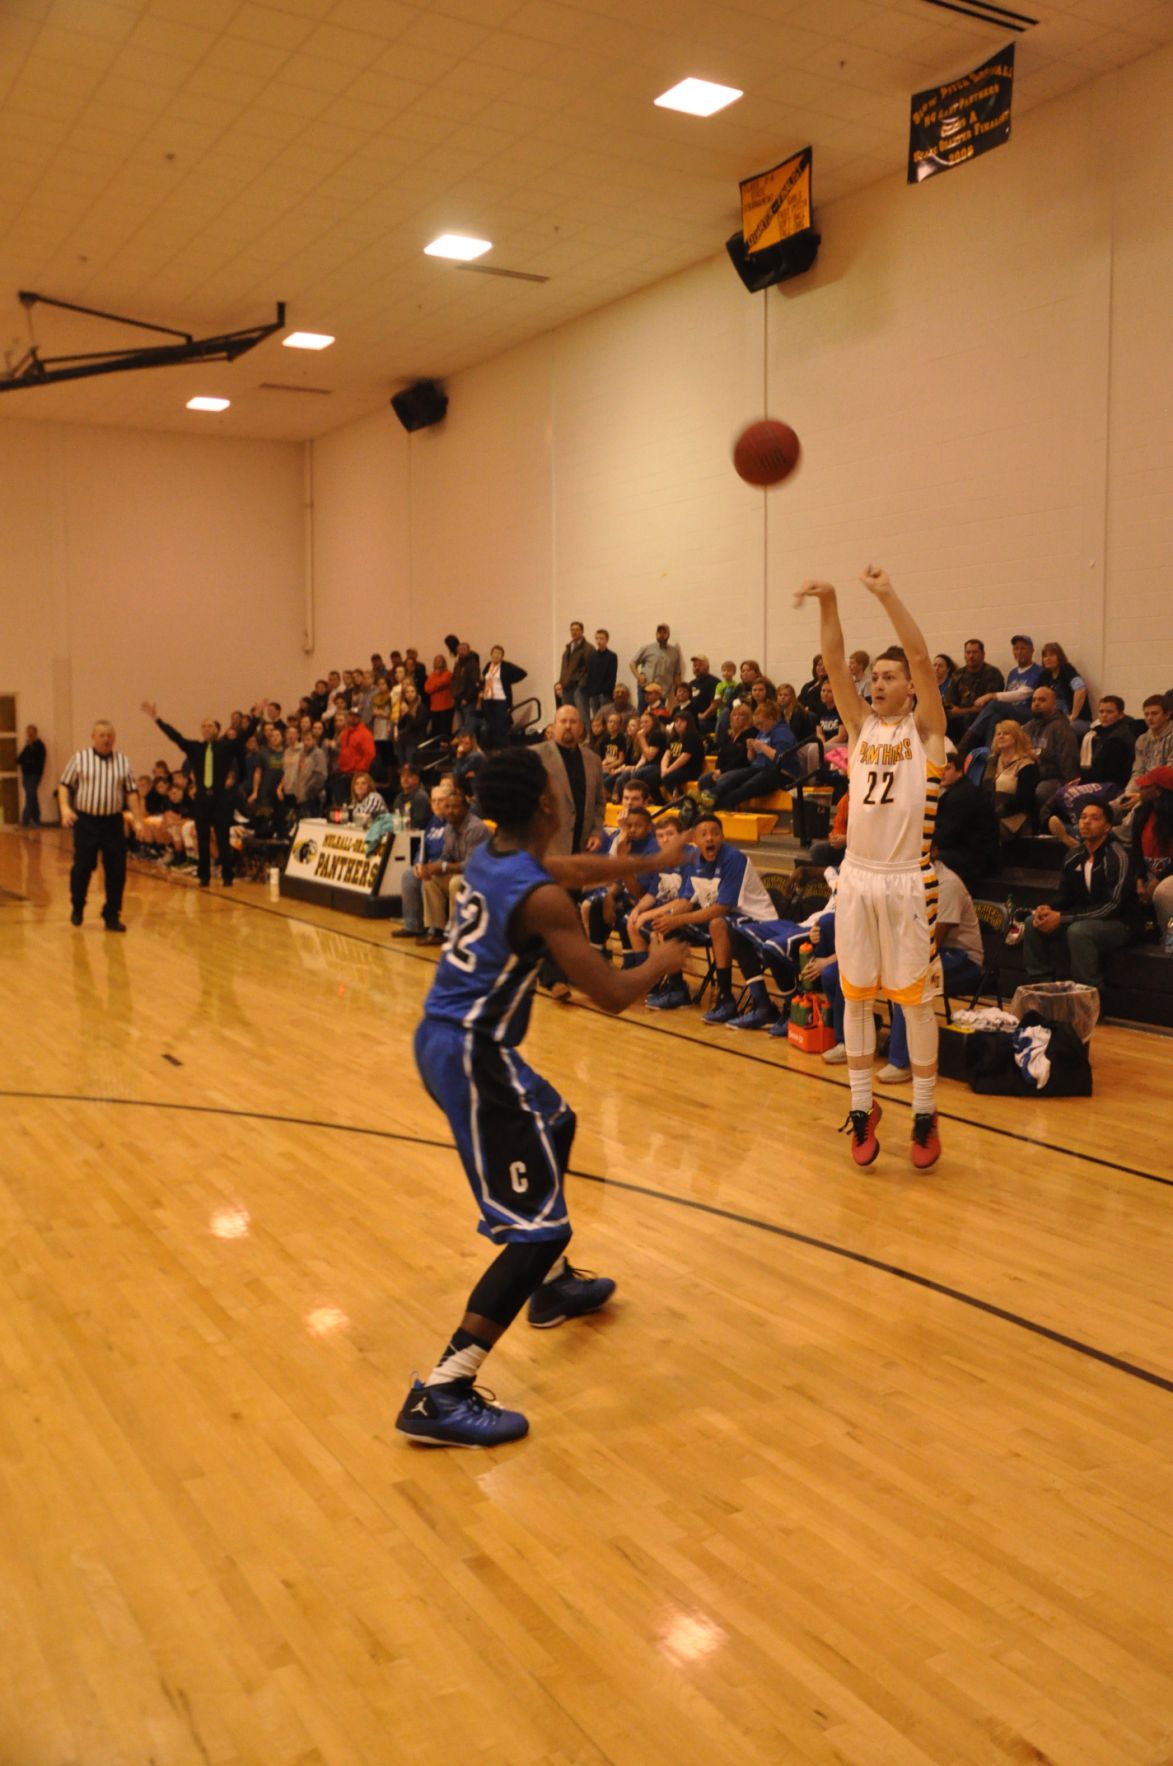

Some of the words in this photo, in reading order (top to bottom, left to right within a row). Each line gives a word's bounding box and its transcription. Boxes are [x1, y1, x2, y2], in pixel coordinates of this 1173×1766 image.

[863, 771, 894, 804] 22
[314, 852, 380, 888] PANTHERS
[509, 1160, 529, 1193] C
